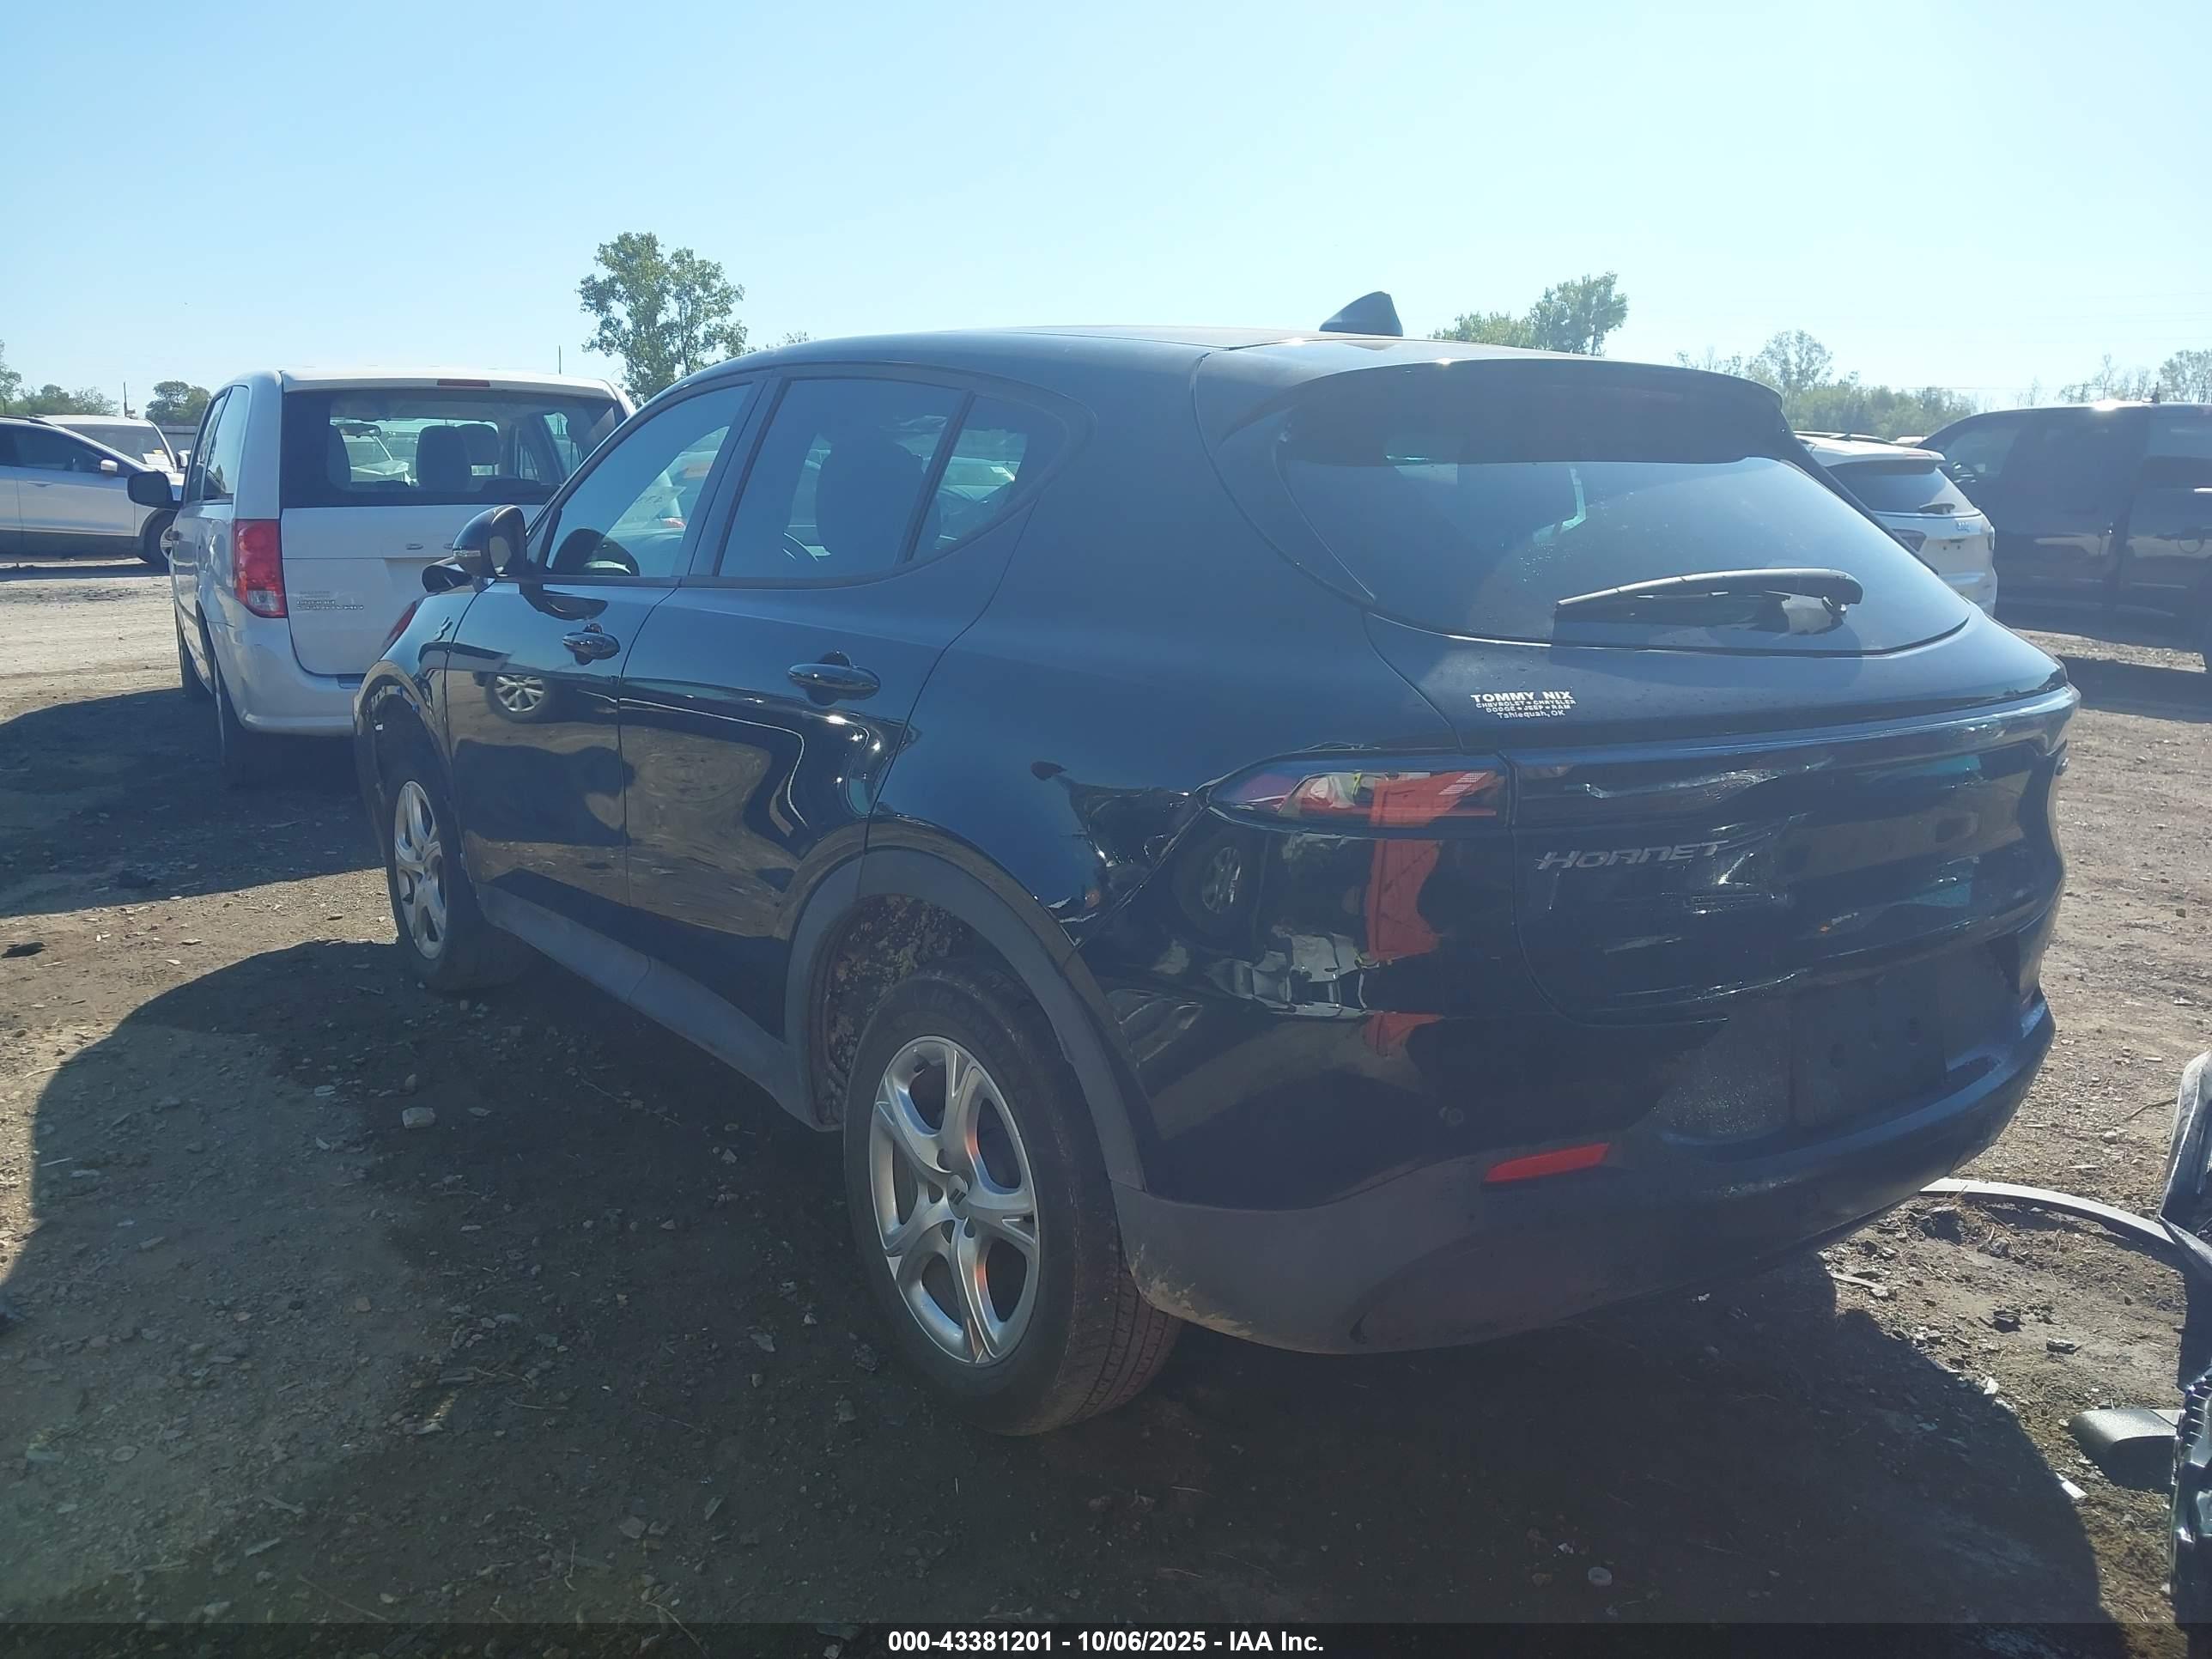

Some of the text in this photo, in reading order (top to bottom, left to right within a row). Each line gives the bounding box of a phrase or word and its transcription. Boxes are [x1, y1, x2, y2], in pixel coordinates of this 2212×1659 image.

[1470, 690, 1573, 702] TOMMY NIX
[1476, 700, 1525, 708] CHEVROLET
[1497, 710, 1551, 719] Tahlequah,
[1534, 839, 1729, 870] HORNET
